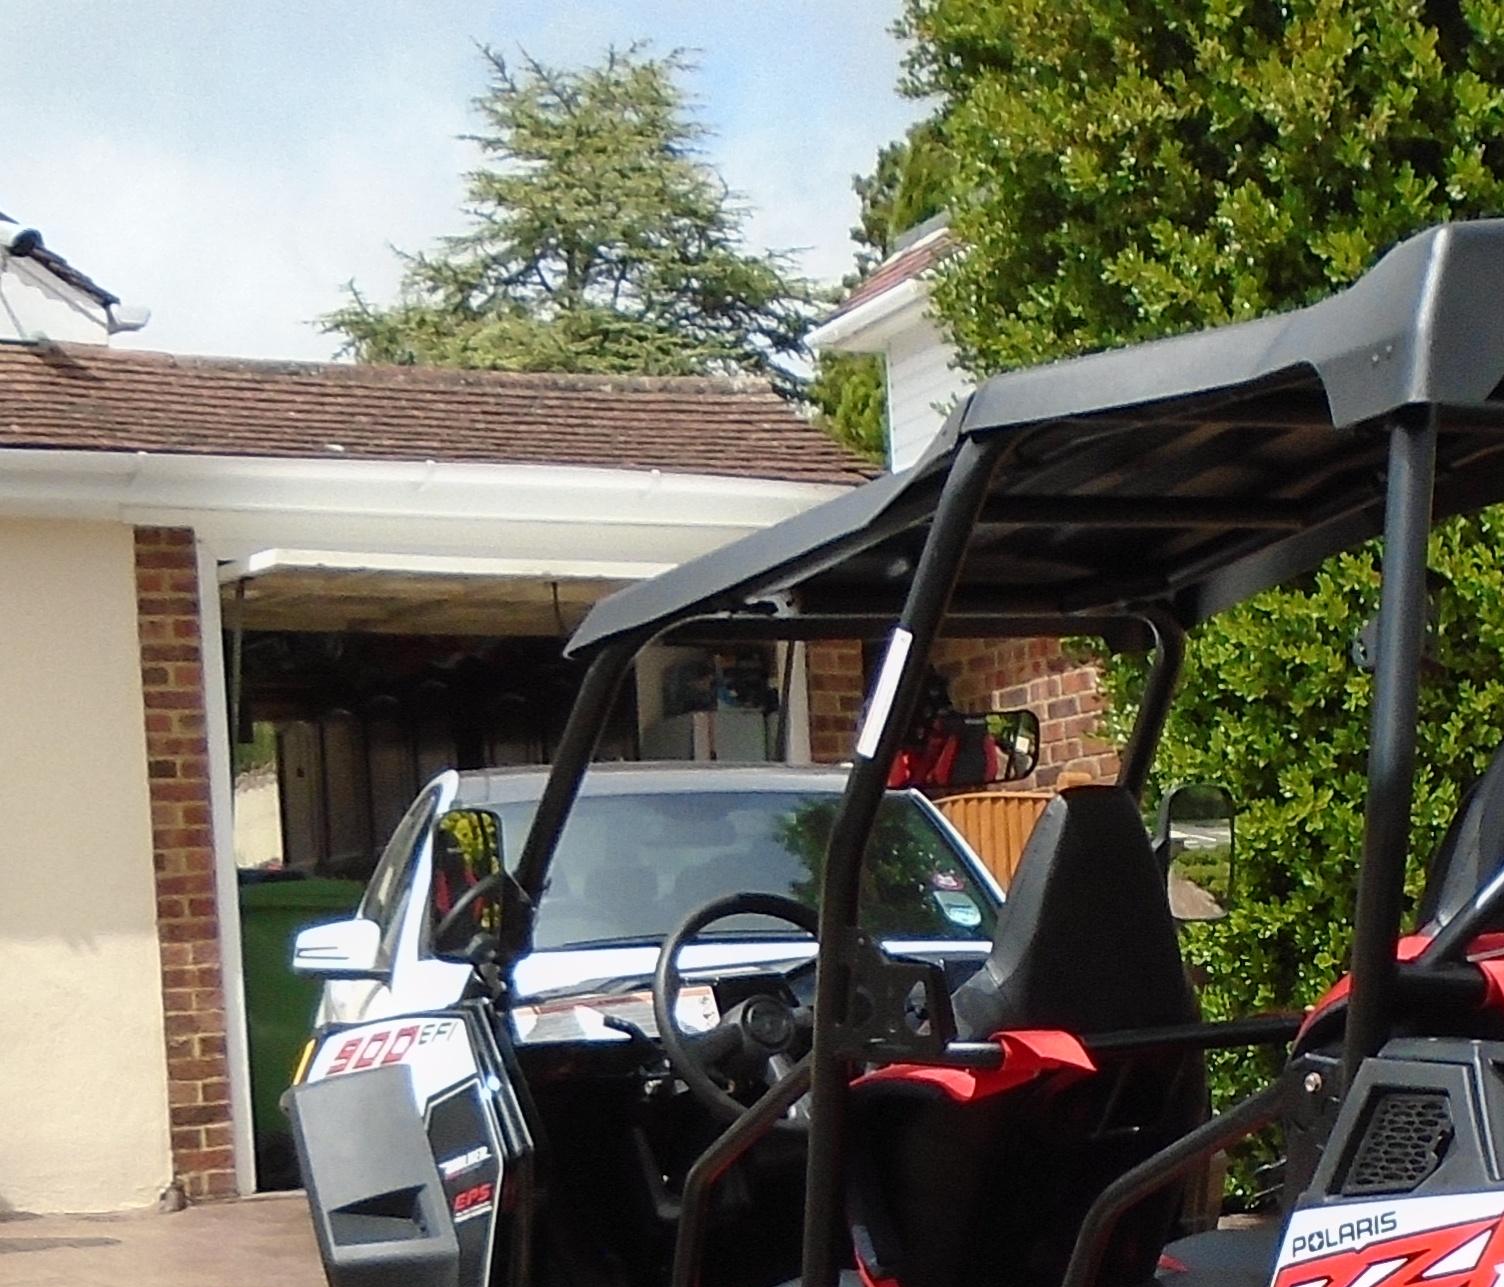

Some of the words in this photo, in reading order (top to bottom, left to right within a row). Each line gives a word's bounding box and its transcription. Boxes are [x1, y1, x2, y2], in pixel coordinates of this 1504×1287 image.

[326, 1024, 421, 1075] 900
[418, 1021, 459, 1045] EFI
[454, 1183, 492, 1211] EPS
[1292, 1210, 1398, 1258] POLARIS
